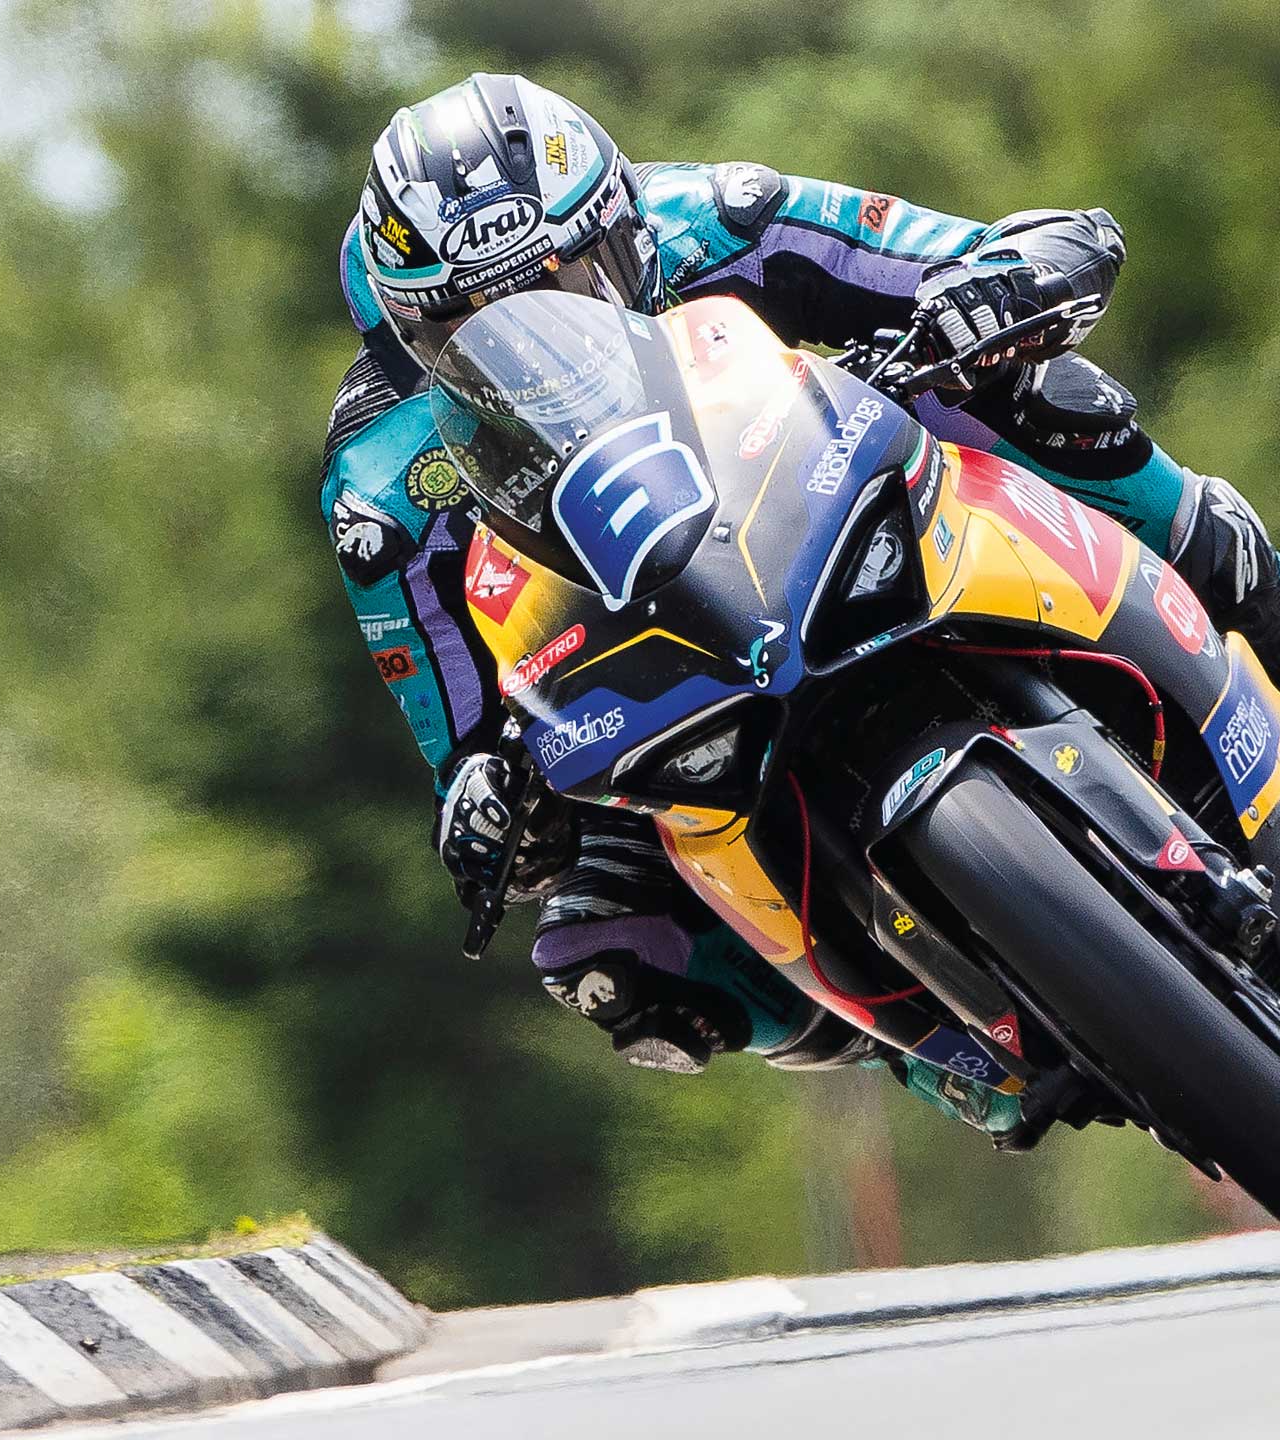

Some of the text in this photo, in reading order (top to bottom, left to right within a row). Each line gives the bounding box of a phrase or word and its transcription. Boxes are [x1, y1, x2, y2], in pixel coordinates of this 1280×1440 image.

[387, 215, 410, 244] TNC
[449, 198, 532, 260] Arai
[457, 237, 553, 290] KELPROPERTIES
[483, 253, 558, 296] PARAMOUNT
[815, 396, 883, 495] mouldings
[503, 631, 578, 692] QUATTRO
[540, 706, 625, 768] mouldings
